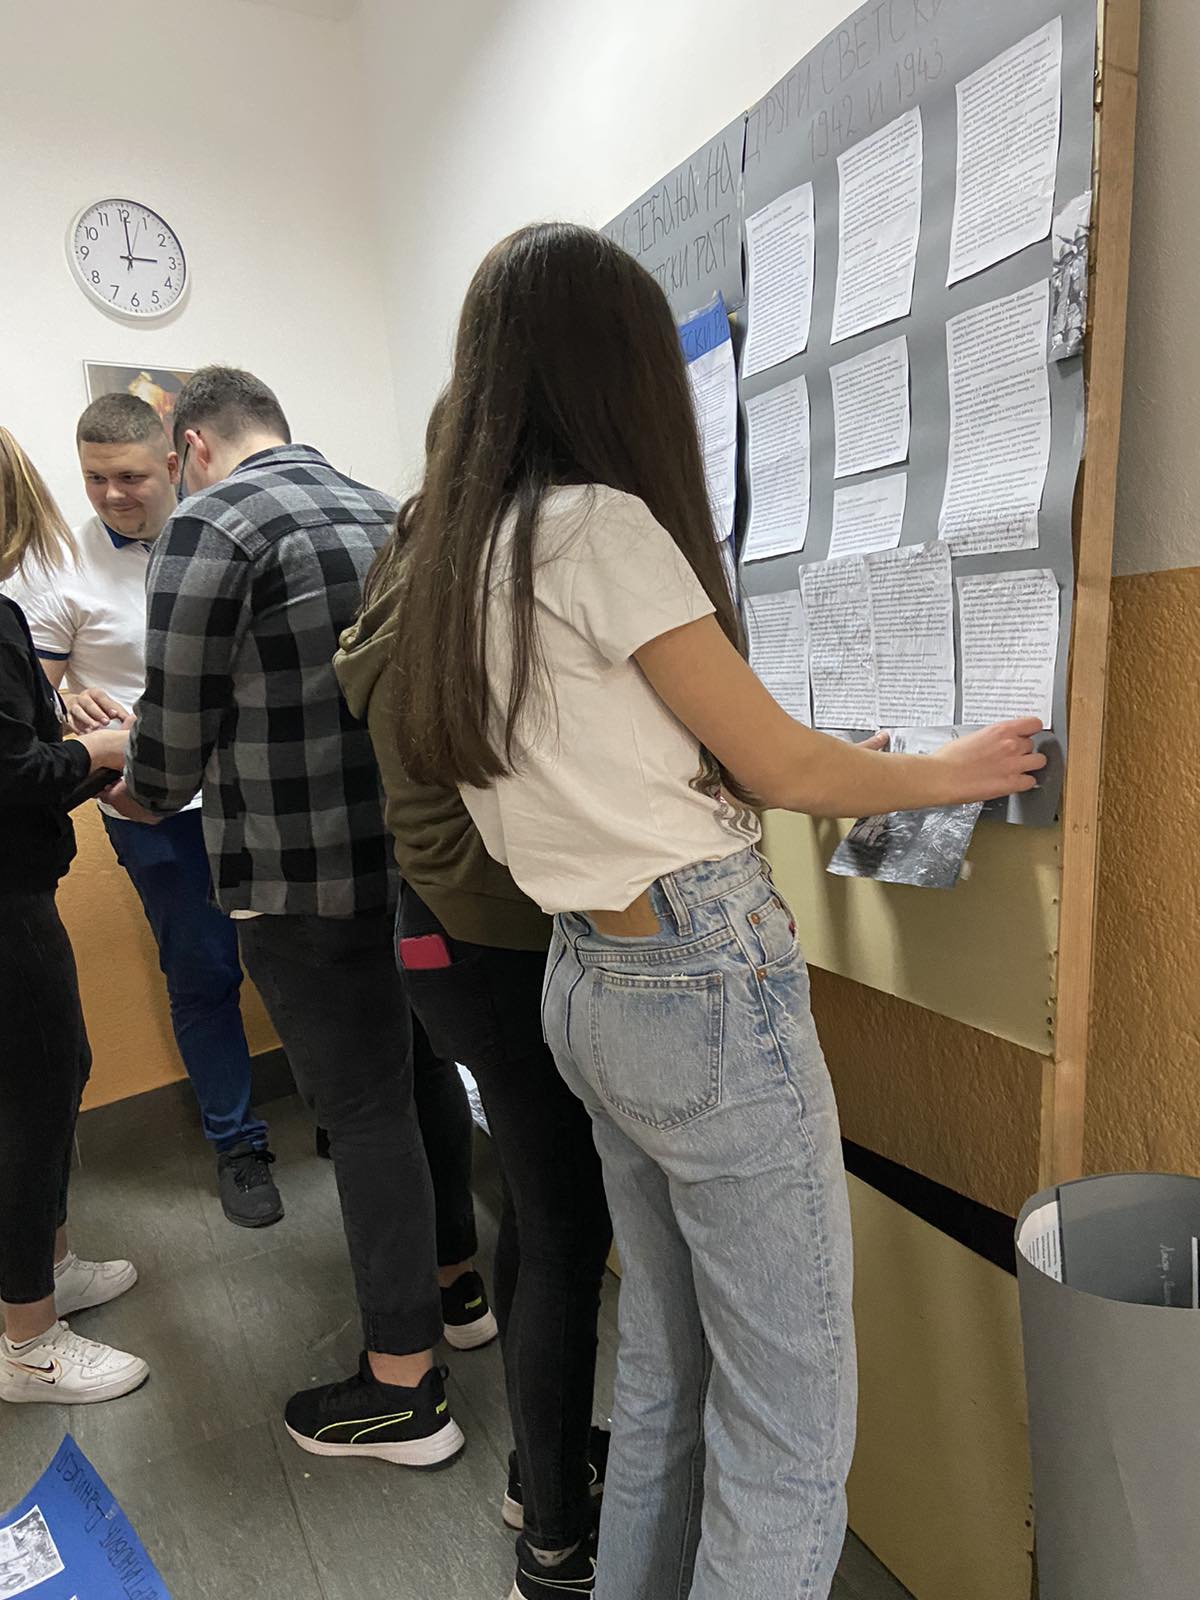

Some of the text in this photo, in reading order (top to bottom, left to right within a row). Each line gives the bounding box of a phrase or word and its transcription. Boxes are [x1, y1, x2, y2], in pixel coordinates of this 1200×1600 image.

[745, 63, 811, 164] ДРУГИ
[808, 95, 861, 165] 1942
[867, 80, 884, 124] И
[704, 142, 735, 212] НА
[98, 212, 109, 227] 11
[117, 208, 131, 223] 12
[142, 217, 148, 230] 1
[85, 226, 98, 241] 10
[157, 233, 167, 247] 2
[80, 245, 90, 260] 9
[693, 214, 731, 281] РАТ
[168, 257, 177, 270] 3
[91, 270, 101, 284] 8
[164, 276, 172, 289] 4
[110, 285, 120, 300] 7
[130, 292, 140, 307] 6
[151, 290, 160, 304] 5
